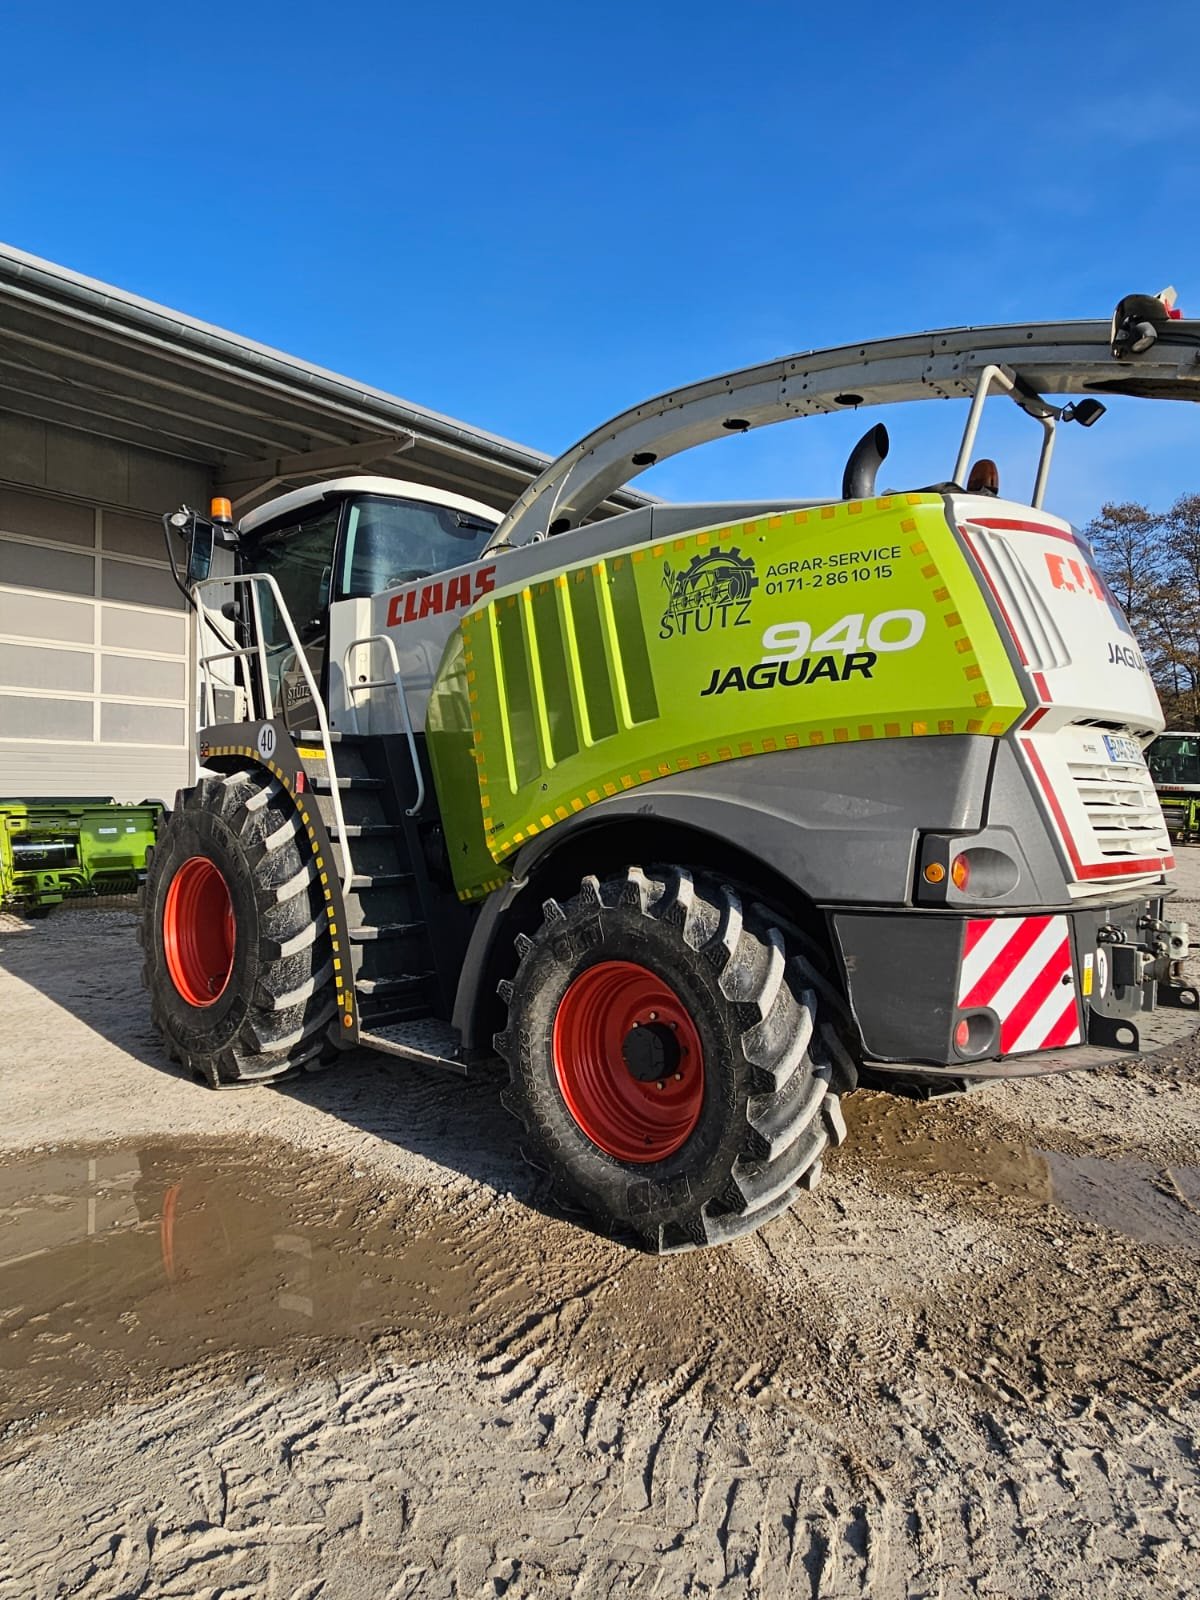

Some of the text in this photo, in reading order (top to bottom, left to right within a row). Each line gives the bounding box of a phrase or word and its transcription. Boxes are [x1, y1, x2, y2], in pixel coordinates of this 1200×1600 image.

[766, 546, 901, 578] AGRAR-SERVICE
[386, 565, 497, 627] CLAAS
[659, 599, 752, 640] STÜTZ
[761, 608, 927, 666] 940
[700, 652, 878, 696] JAGUAR
[260, 730, 273, 751] 40
